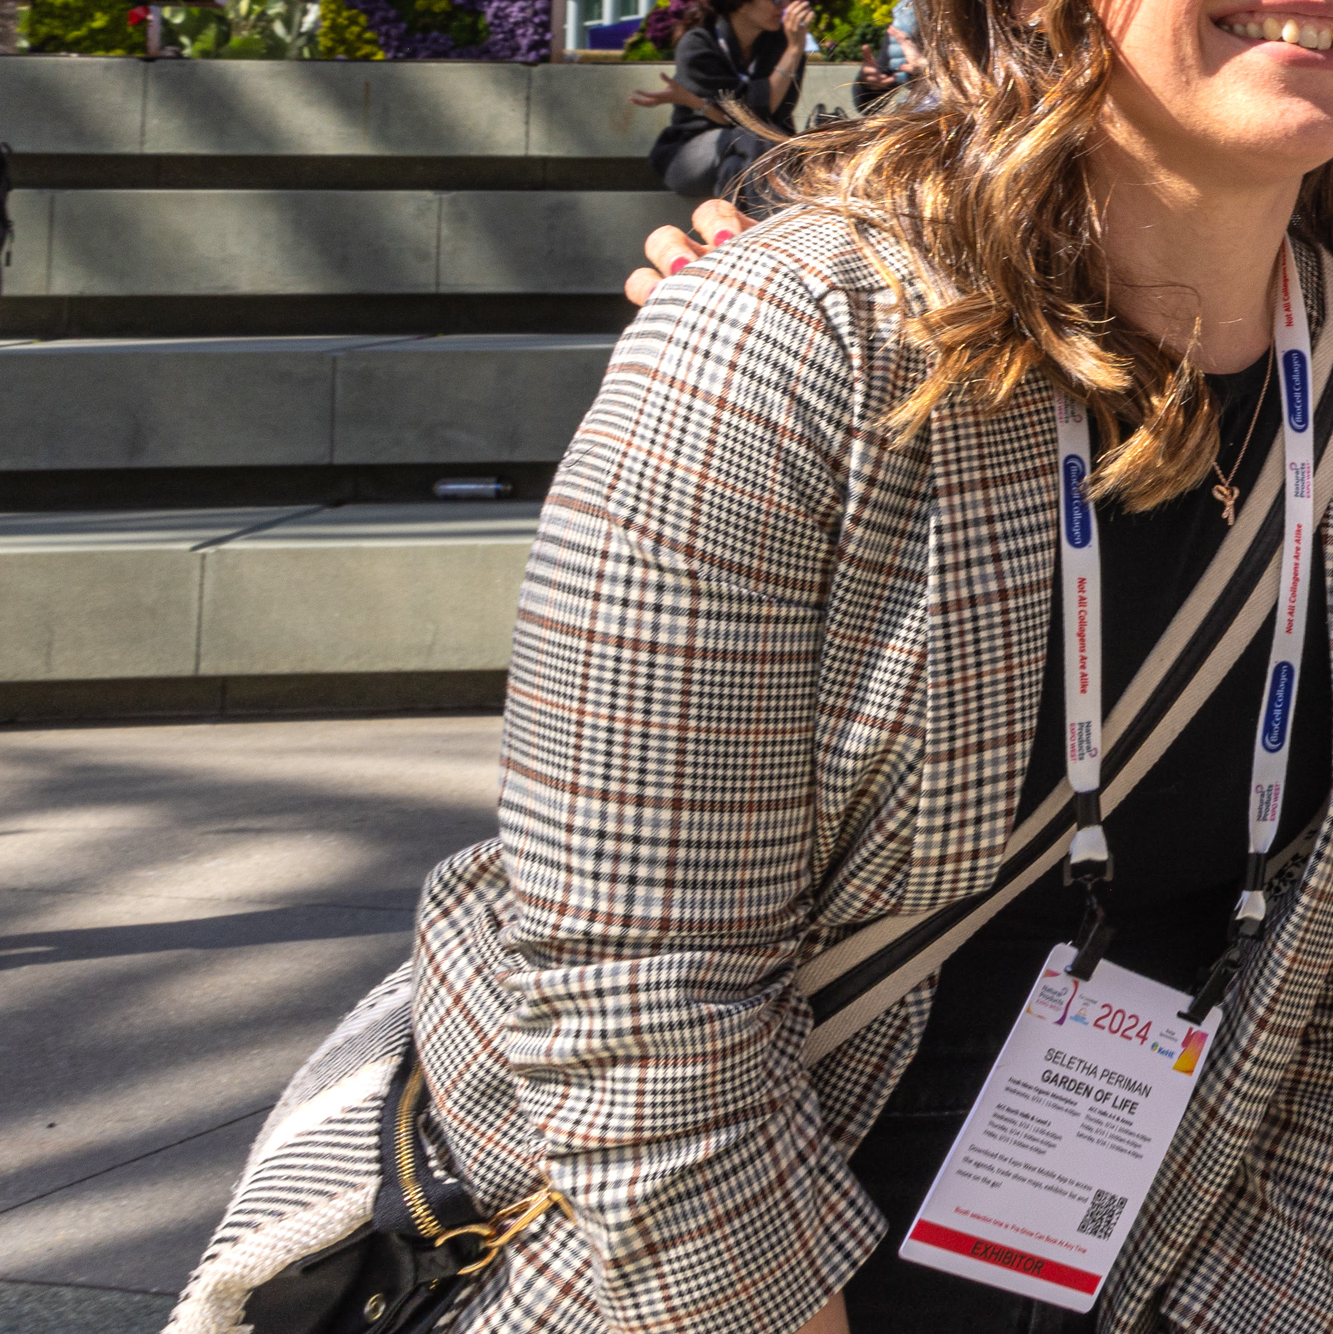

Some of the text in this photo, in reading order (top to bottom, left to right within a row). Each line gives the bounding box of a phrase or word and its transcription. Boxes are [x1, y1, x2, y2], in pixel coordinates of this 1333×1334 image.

[1283, 302, 1291, 313] All
[1285, 313, 1293, 327] Not
[1292, 352, 1302, 425] BioCell Collagen
[1292, 467, 1304, 498] Natural
[1297, 462, 1306, 498] Products
[1072, 499, 1082, 545] Collagen
[1285, 523, 1302, 635] Not All Collagens Are Alike
[1076, 577, 1089, 694] Not All Collagens Are Alike
[1268, 665, 1288, 742] BioCell Collagen
[1075, 721, 1086, 762] Products
[1083, 720, 1093, 753] Natural
[1256, 790, 1266, 822] Natural
[1261, 784, 1274, 822] Products
[1093, 1003, 1152, 1045] 2024
[1041, 1069, 1094, 1098] GARDEN
[1094, 1089, 1113, 1104] OF
[1111, 1095, 1139, 1115] LIFE
[1044, 1048, 1098, 1078] SELETHA
[1099, 1068, 1152, 1098] PERIMAN
[970, 1239, 1045, 1276] EXHIBITOR
